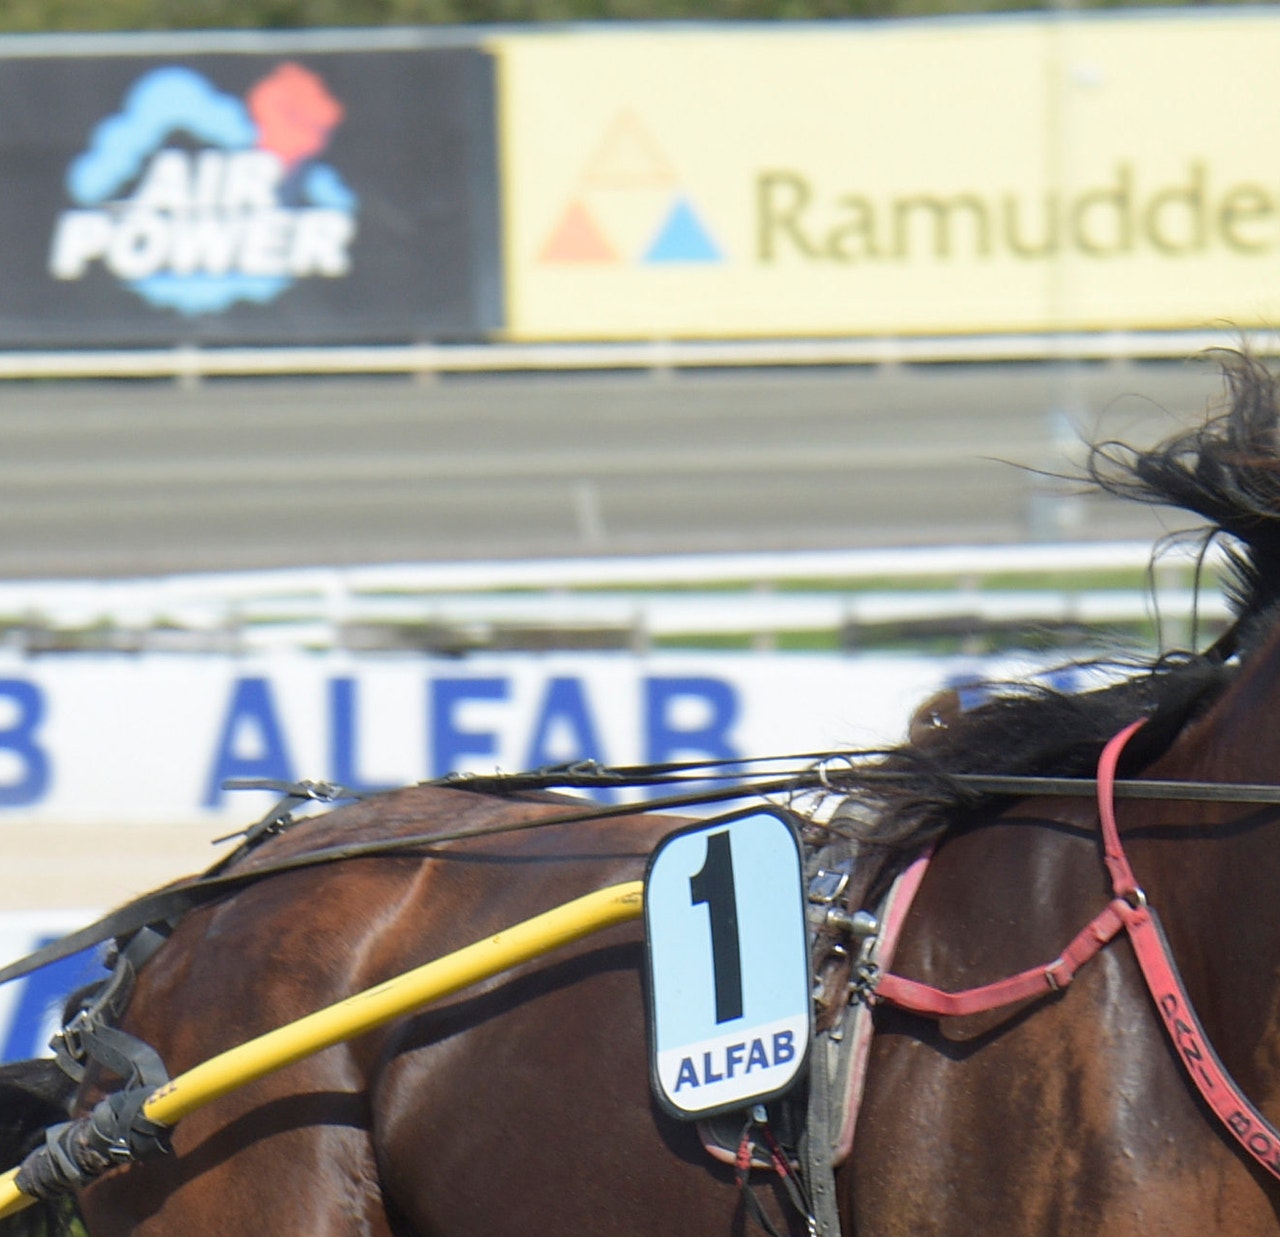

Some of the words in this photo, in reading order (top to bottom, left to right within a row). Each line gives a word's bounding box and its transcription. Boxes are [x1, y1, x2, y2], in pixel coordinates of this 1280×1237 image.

[132, 150, 284, 208] AIR
[50, 208, 357, 280] POWER
[198, 677, 744, 808] ALFAB
[689, 830, 744, 1025] 1
[674, 1030, 795, 1093] ALFAB
